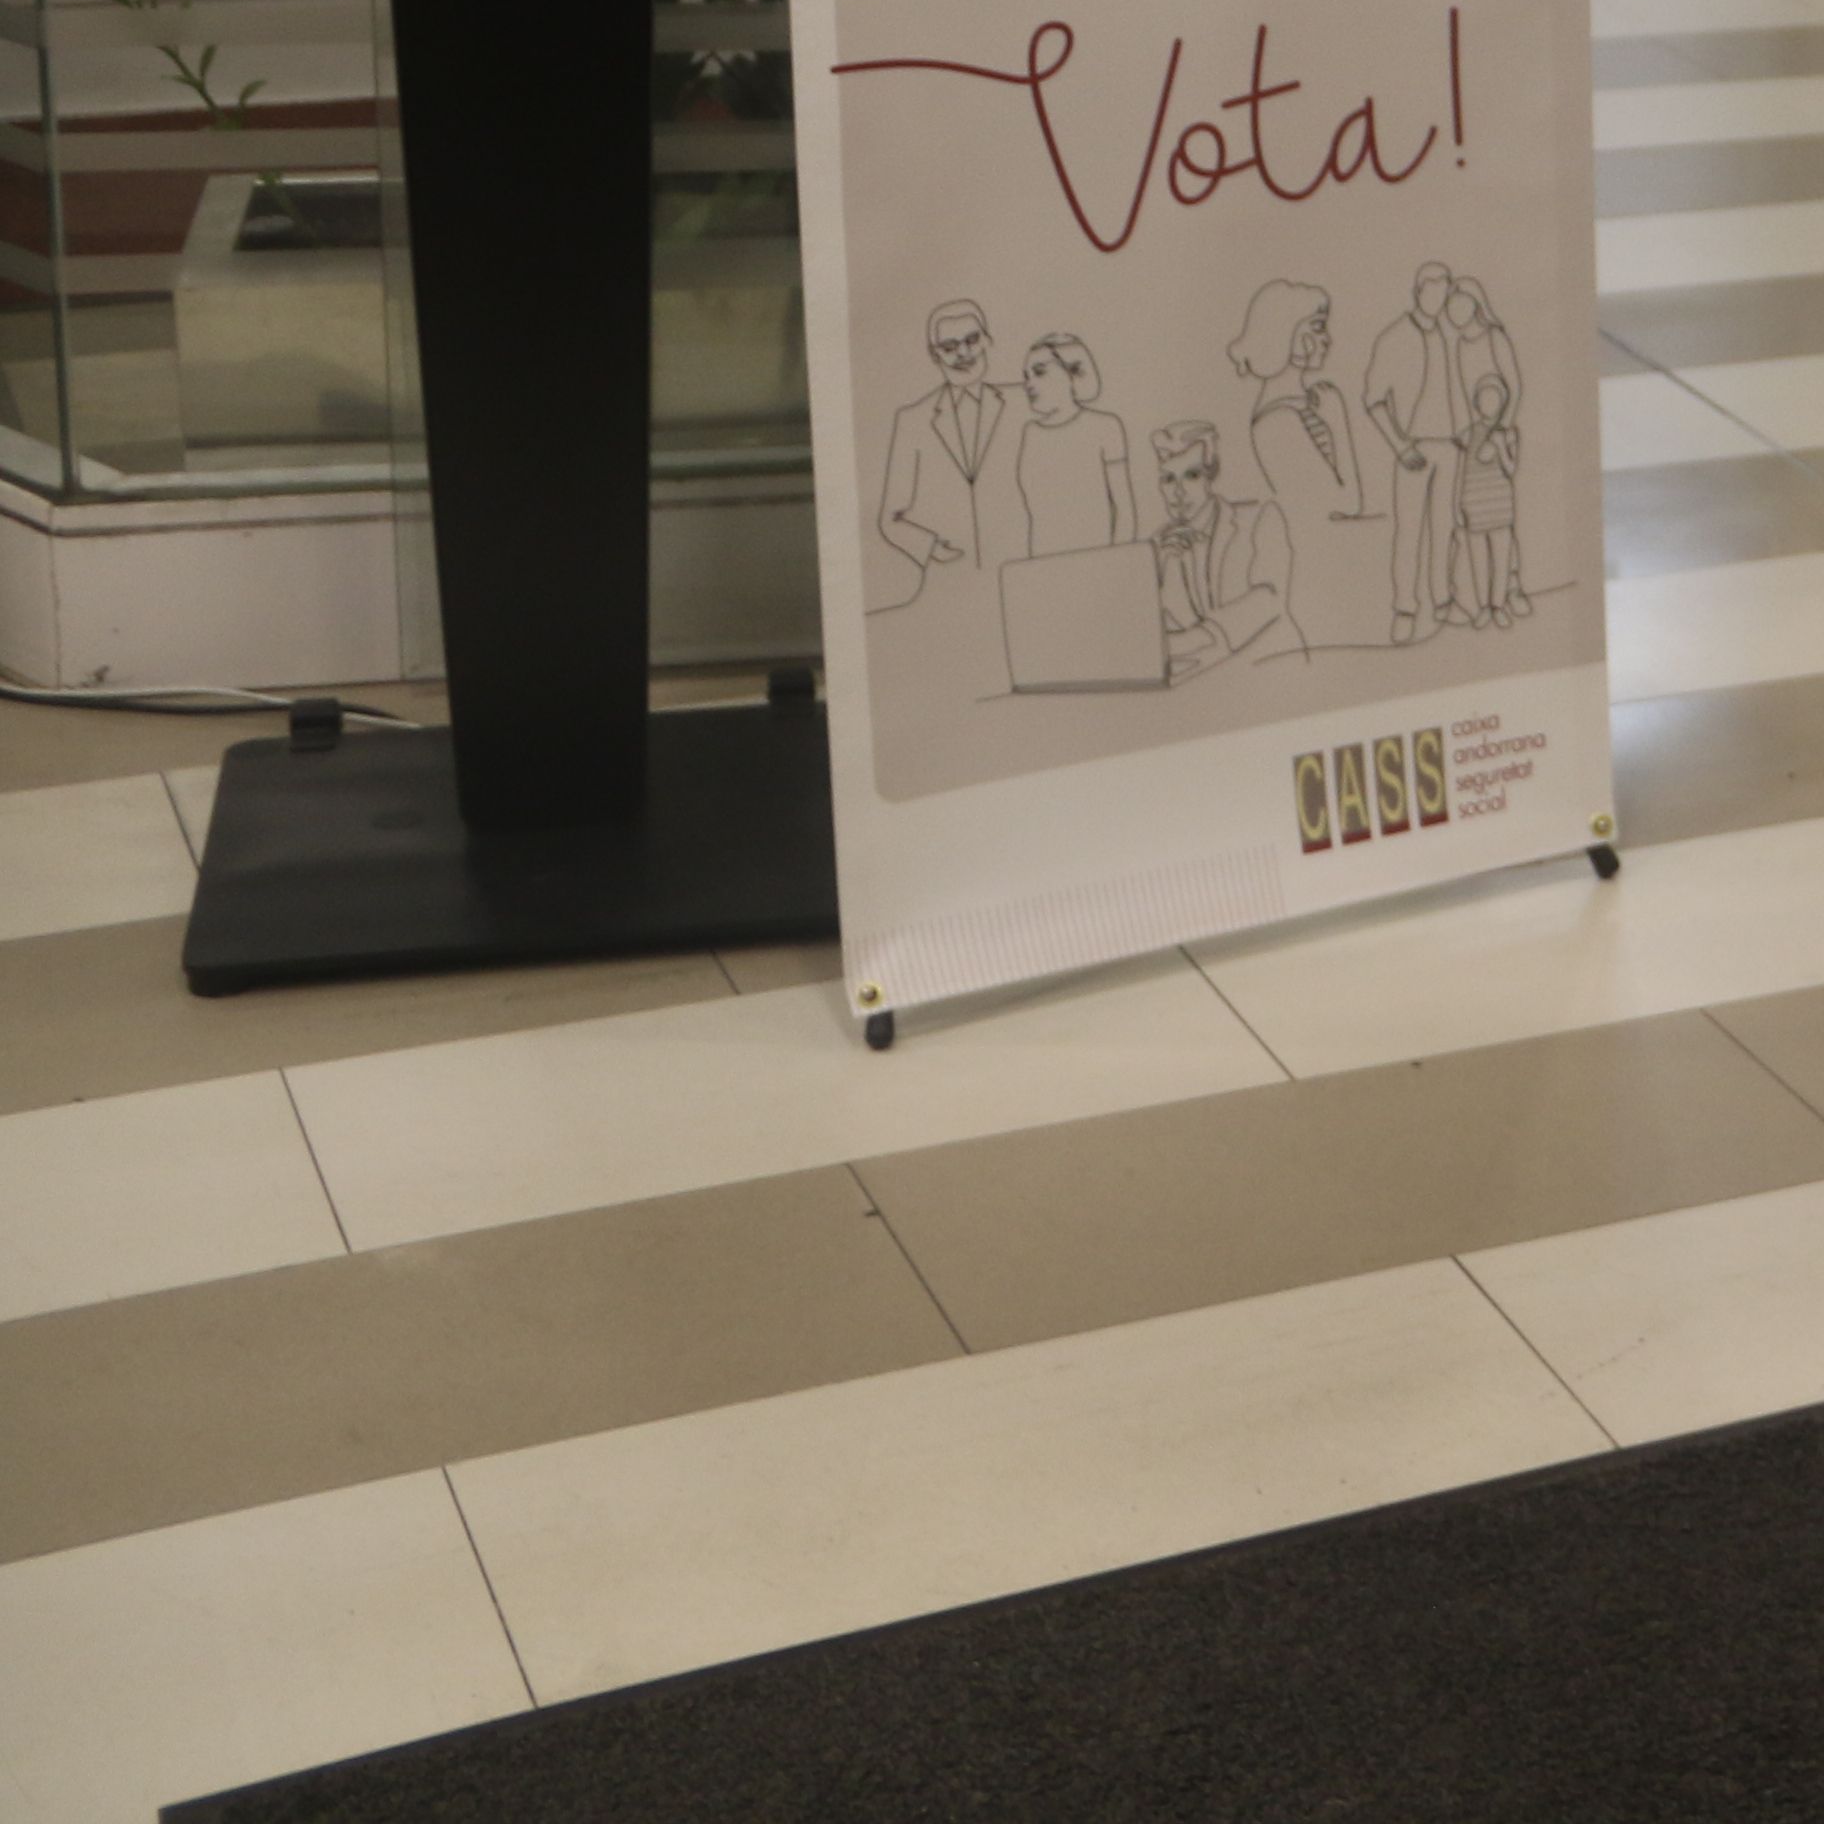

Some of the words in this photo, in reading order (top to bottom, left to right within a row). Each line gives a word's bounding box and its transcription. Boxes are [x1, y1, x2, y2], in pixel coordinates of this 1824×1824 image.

[830, 6, 1468, 253] Vota!
[1451, 712, 1501, 737] caixa
[1453, 731, 1547, 765] andorrana
[1298, 730, 1446, 842] CASS
[1455, 759, 1534, 795] seguretat
[1457, 789, 1507, 819] social
